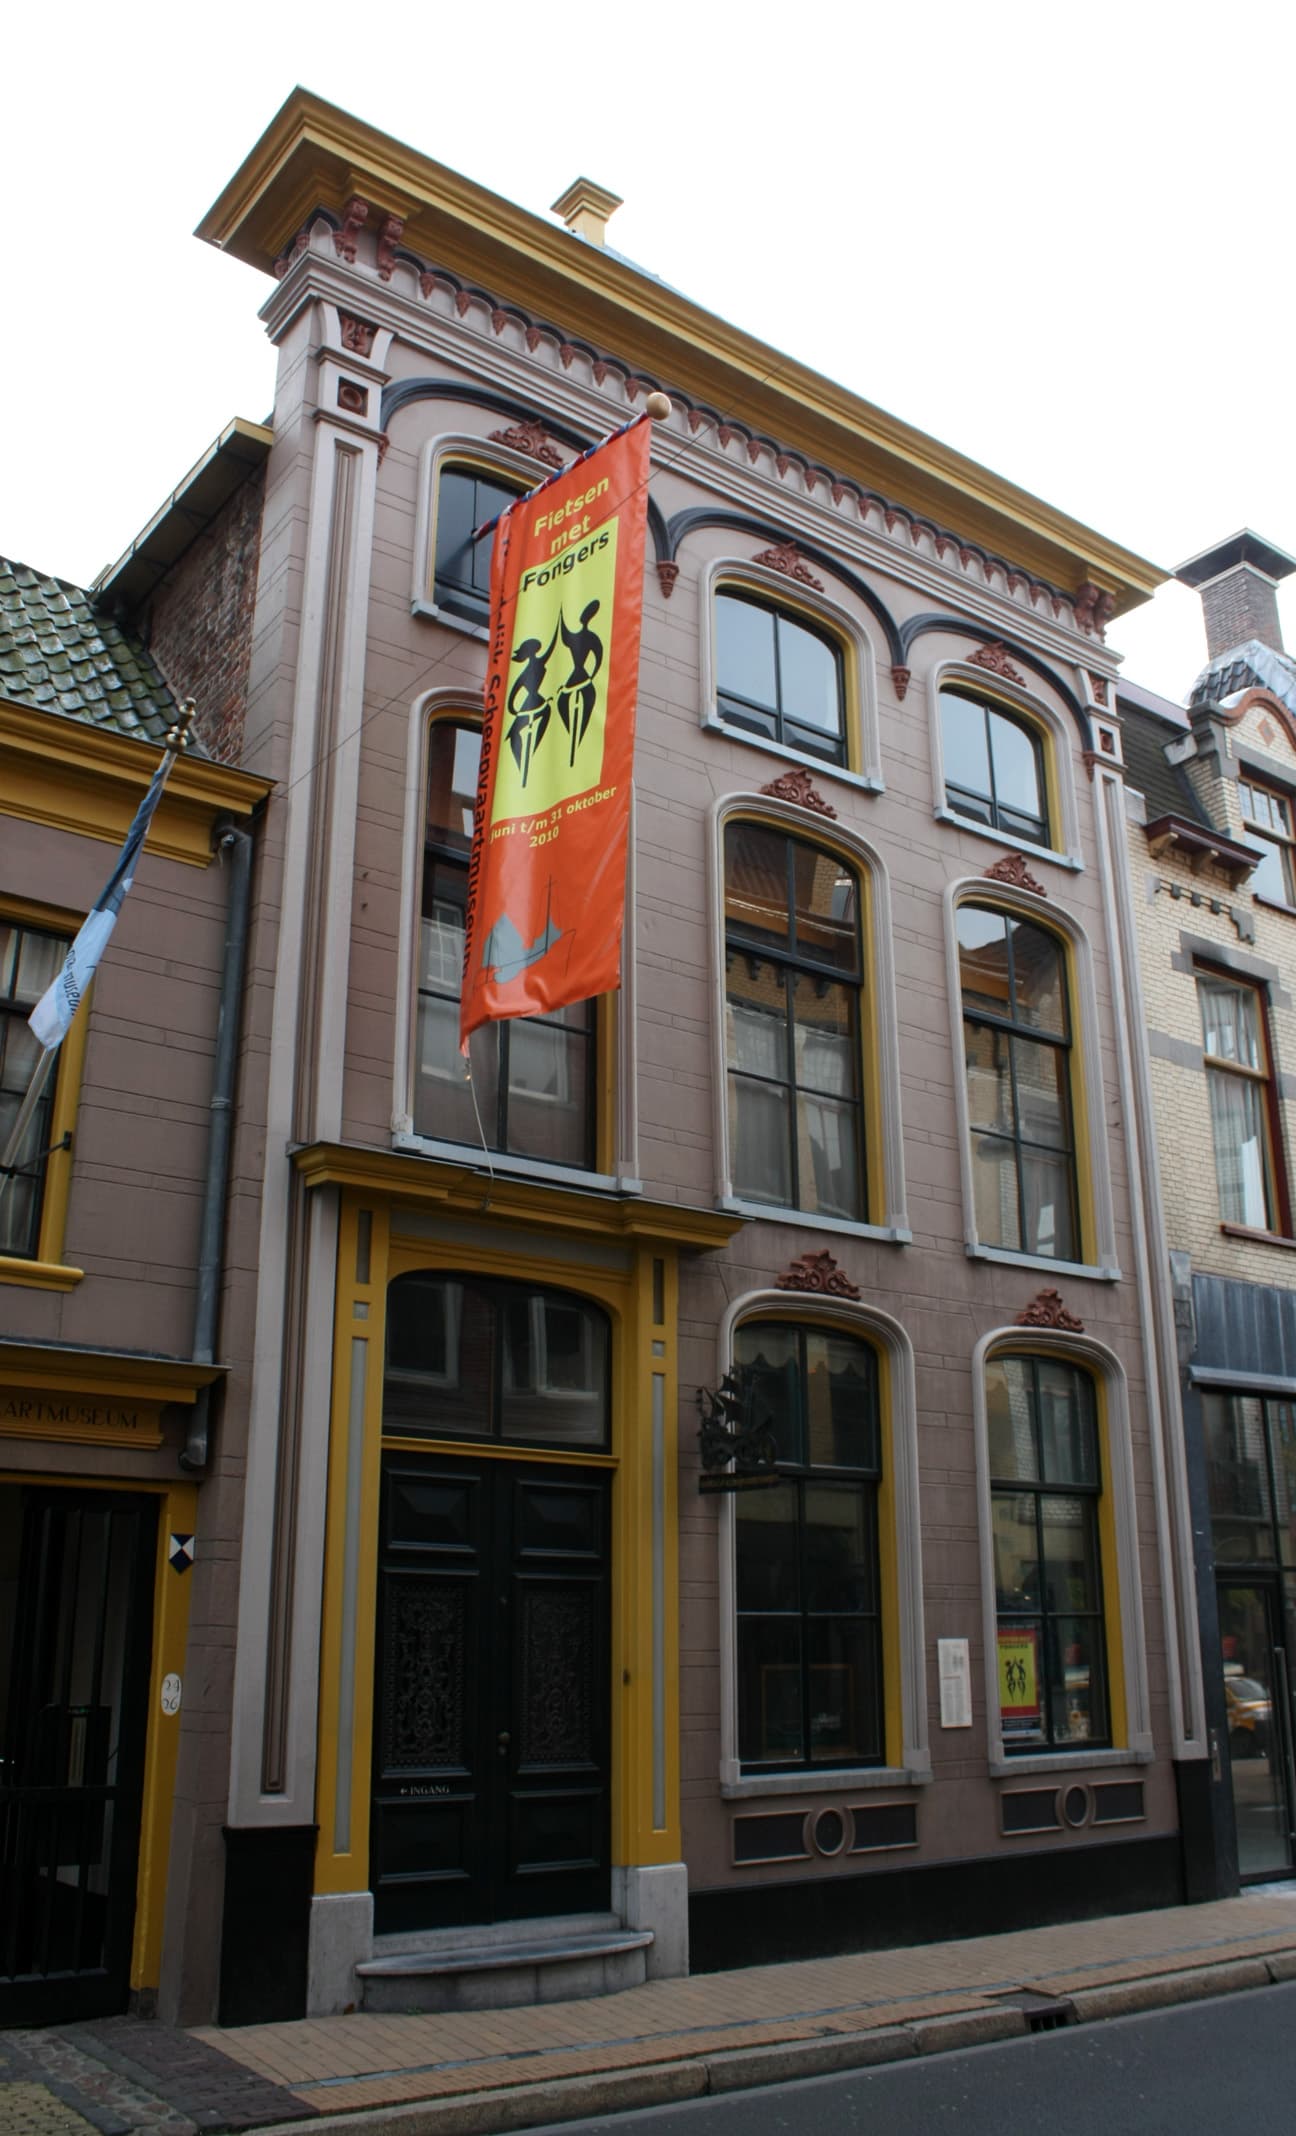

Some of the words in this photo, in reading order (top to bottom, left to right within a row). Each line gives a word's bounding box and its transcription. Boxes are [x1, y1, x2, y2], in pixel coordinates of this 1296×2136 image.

[533, 476, 609, 537] Fietsen
[550, 514, 591, 555] met
[522, 530, 610, 592] Fongers
[490, 823, 516, 845] juni
[520, 818, 548, 835] t/m
[551, 808, 563, 825] 31
[566, 786, 617, 815] oktober
[529, 826, 560, 848] 2010
